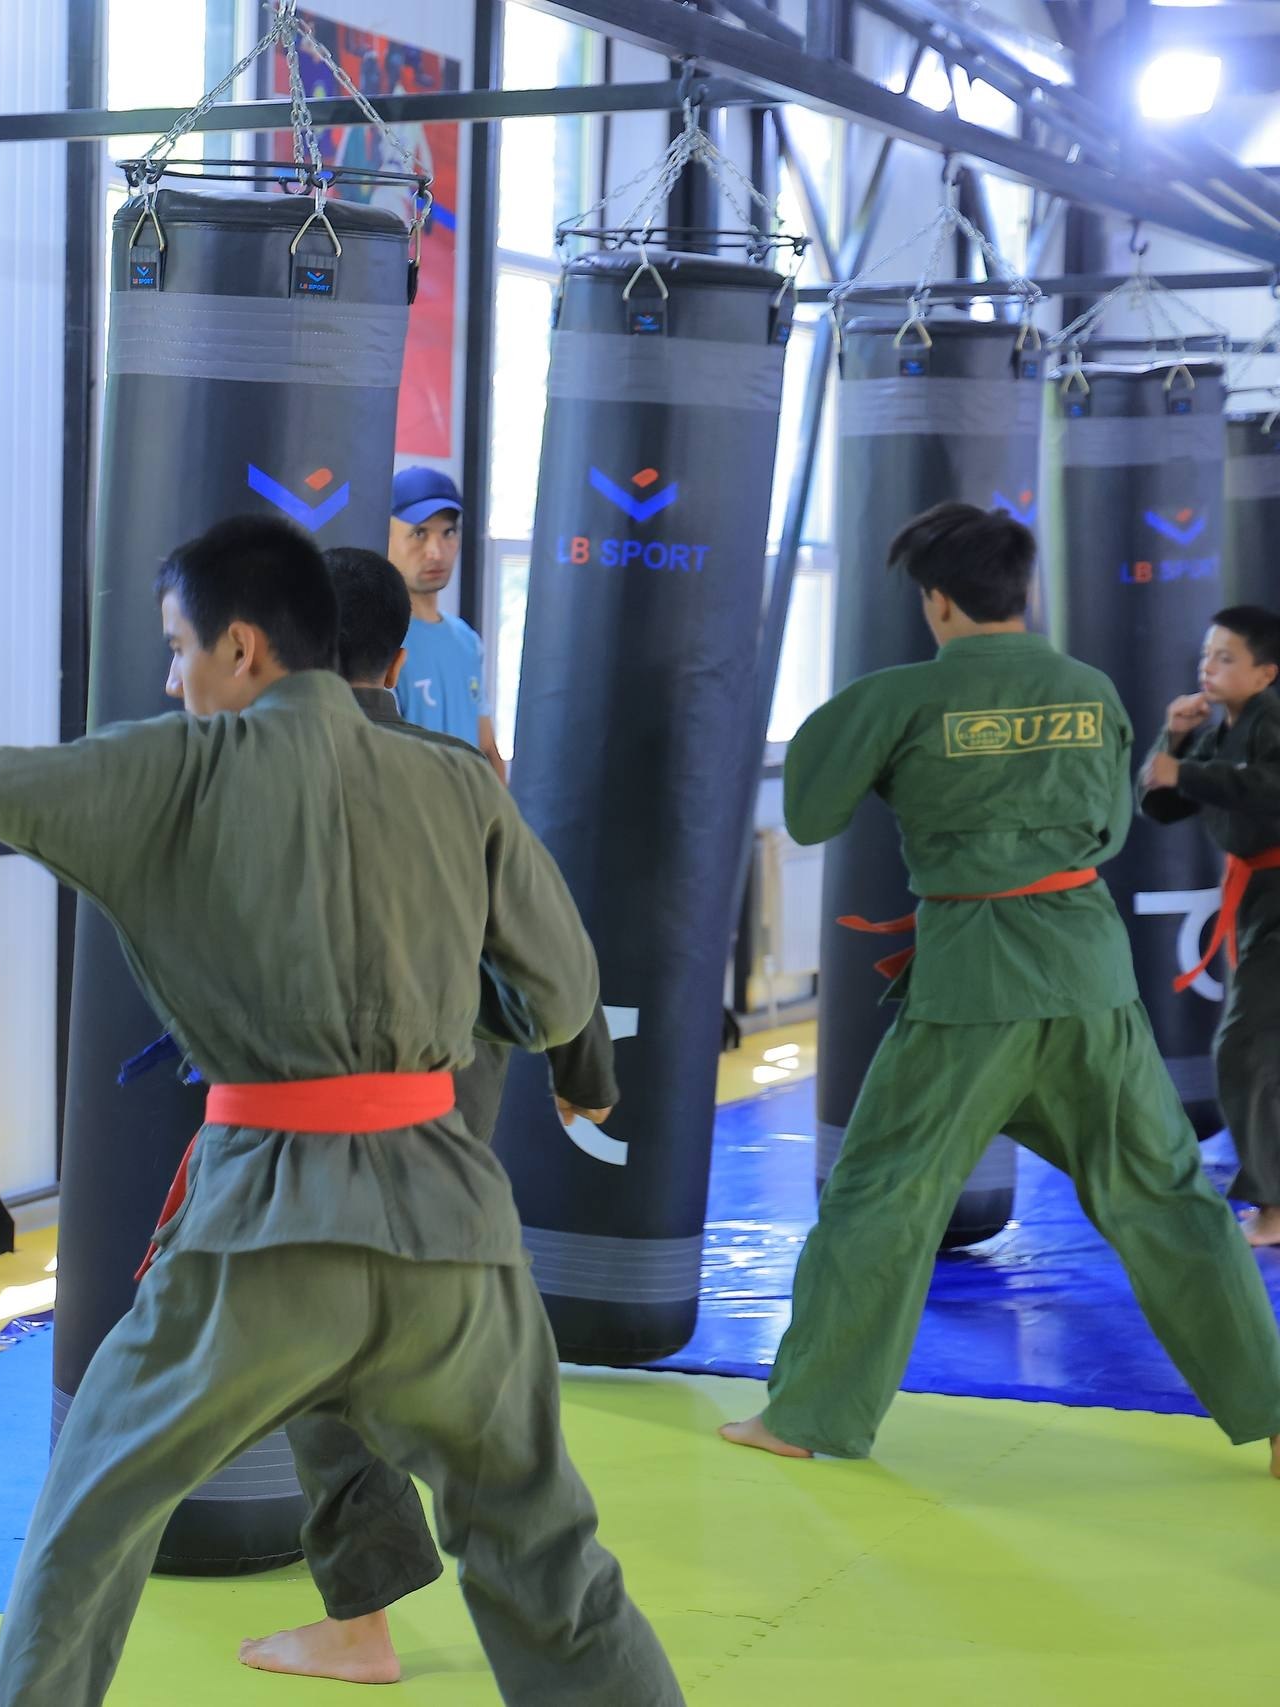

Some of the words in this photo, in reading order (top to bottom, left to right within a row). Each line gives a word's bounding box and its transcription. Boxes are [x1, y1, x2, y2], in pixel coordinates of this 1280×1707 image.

[557, 536, 590, 565] LB
[600, 538, 711, 573] SPORT
[1120, 560, 1153, 584] LB
[1013, 711, 1096, 746] UZB
